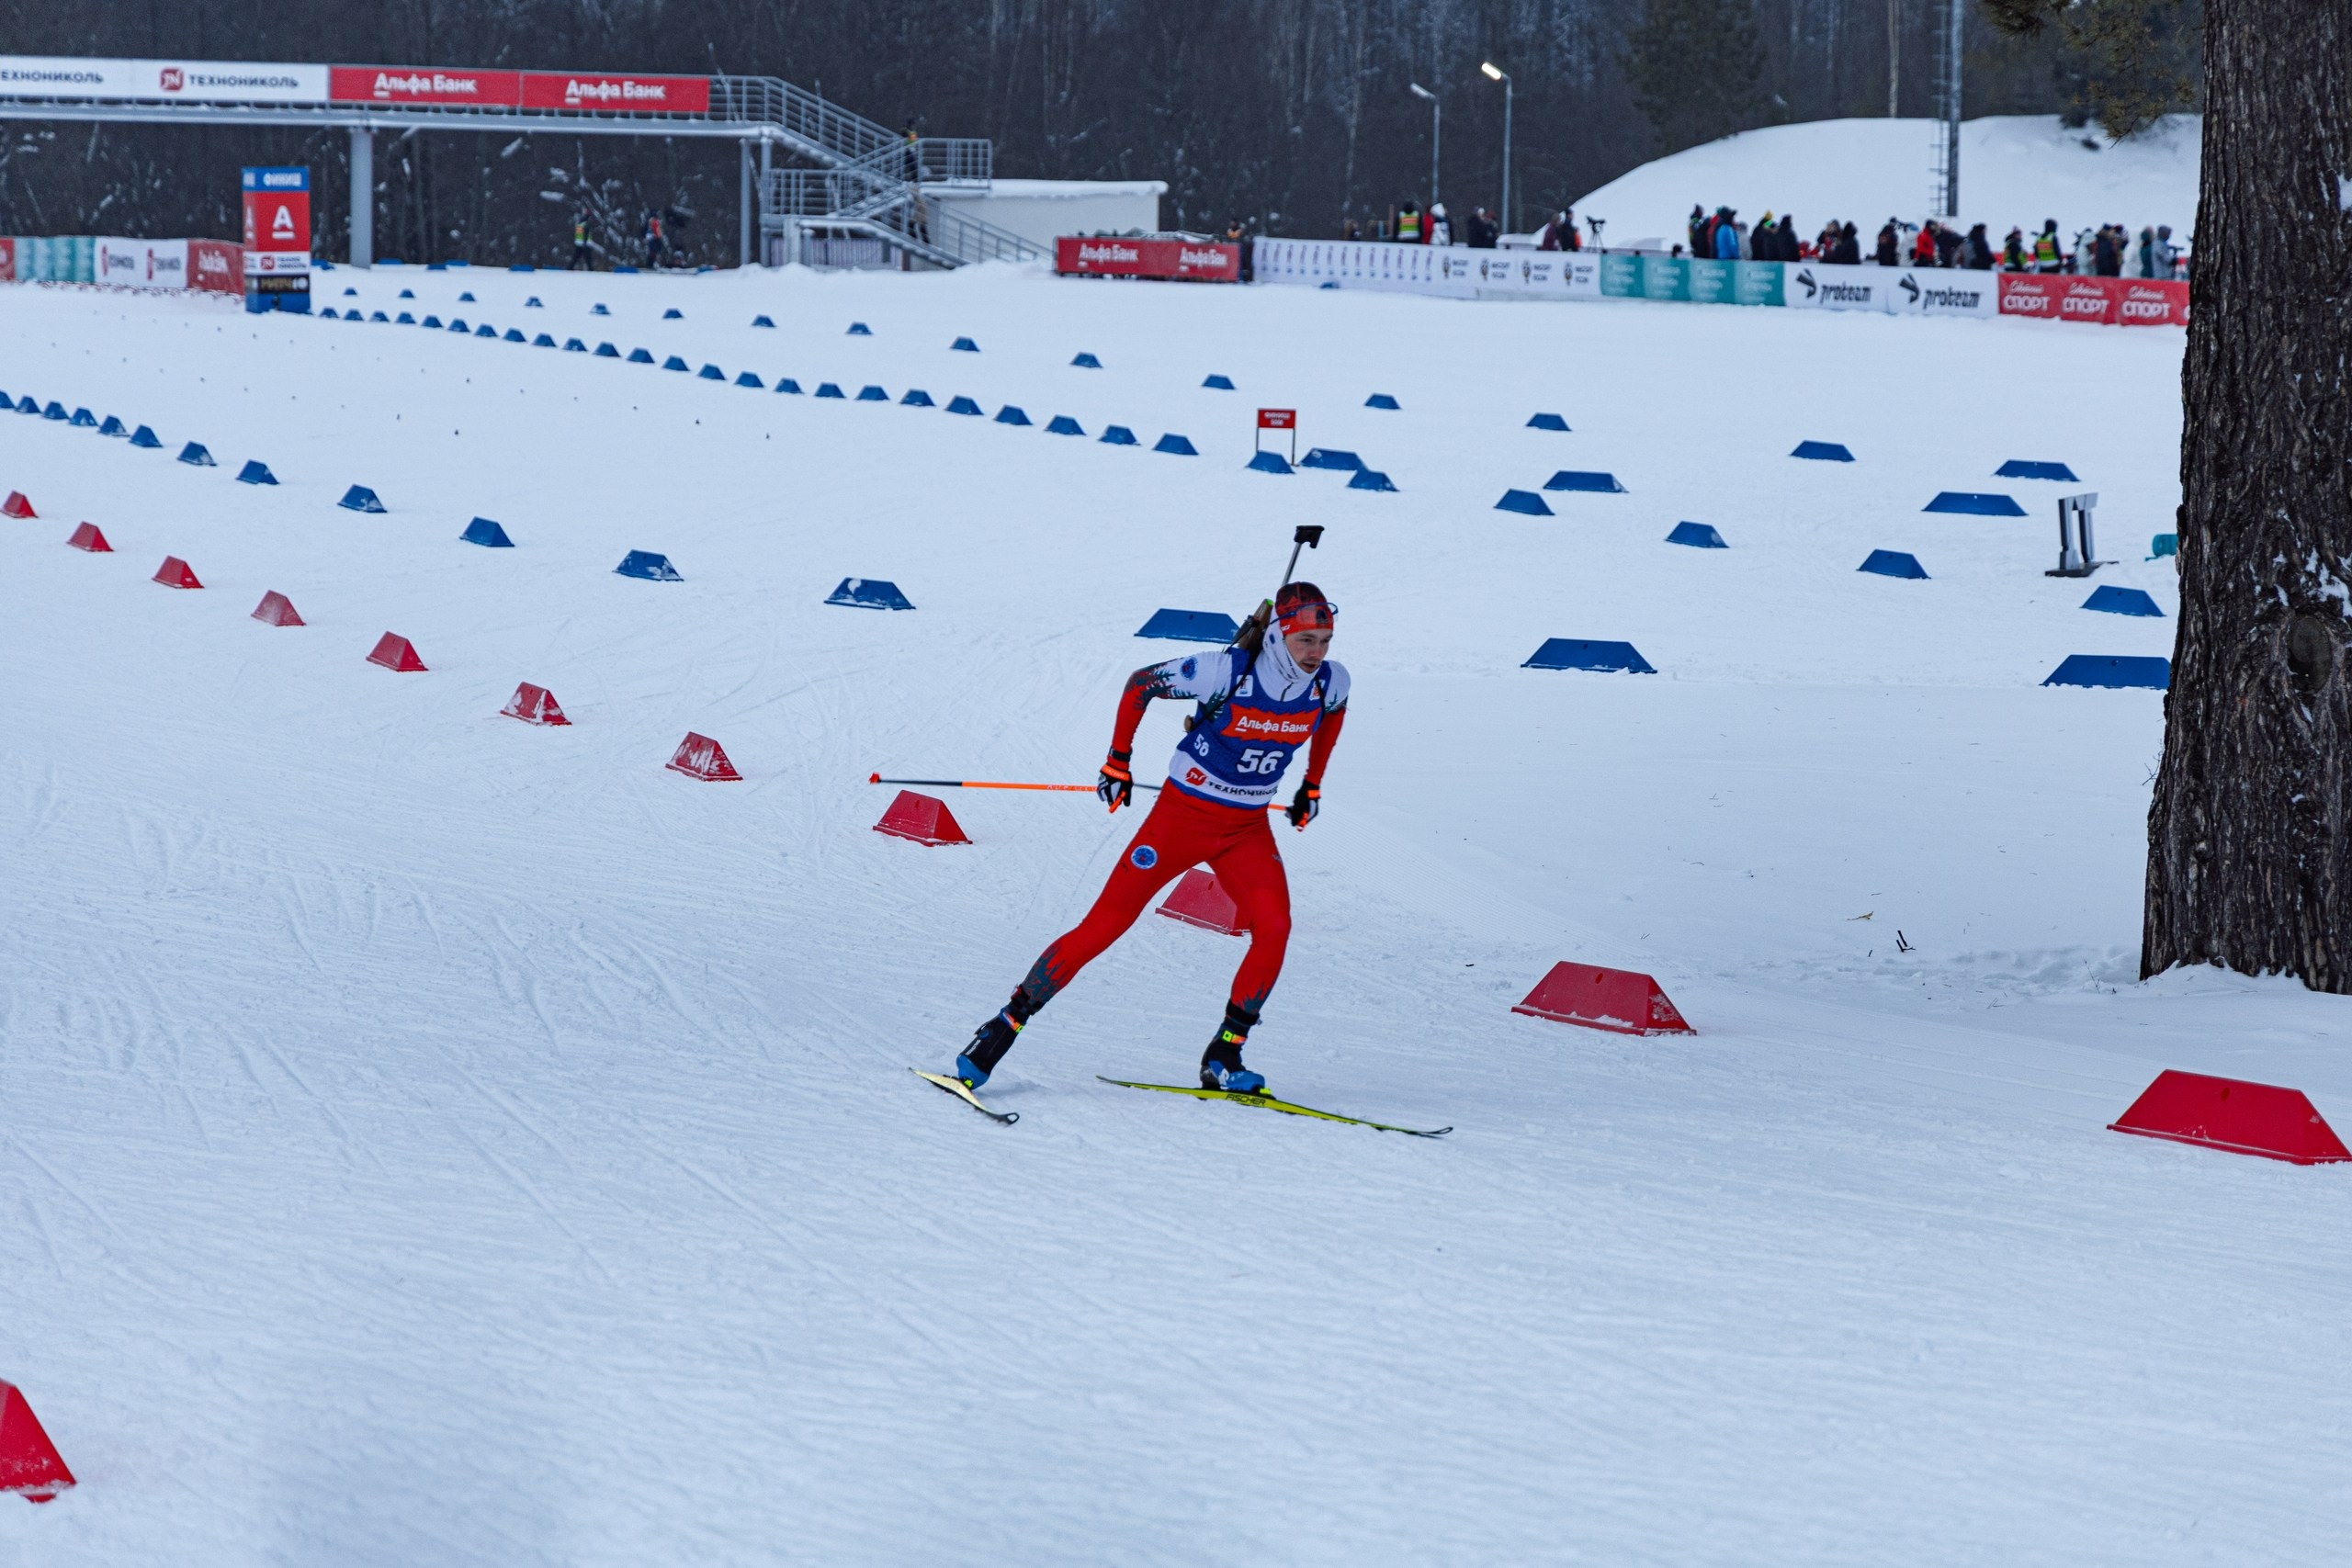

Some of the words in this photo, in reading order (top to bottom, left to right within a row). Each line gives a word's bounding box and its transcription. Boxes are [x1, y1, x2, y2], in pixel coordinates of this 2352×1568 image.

[1, 70, 104, 84] ЕХНОНИКОЛЬ
[189, 74, 299, 87] ТЕХНОНИКОЛЬ
[374, 73, 431, 96] Альфа
[433, 74, 478, 93] Банк
[565, 79, 621, 103] Альфа
[623, 81, 666, 100] Банк
[2003, 295, 2050, 311] СПОРТ
[2063, 297, 2109, 313] СПОРТ
[2121, 300, 2171, 317] СПОРТ
[1237, 716, 1279, 733] Альфа
[1281, 721, 1309, 732] Банк
[1194, 734, 1209, 756] 56
[1237, 749, 1283, 774] 56
[1226, 1093, 1266, 1106] FISCHER
